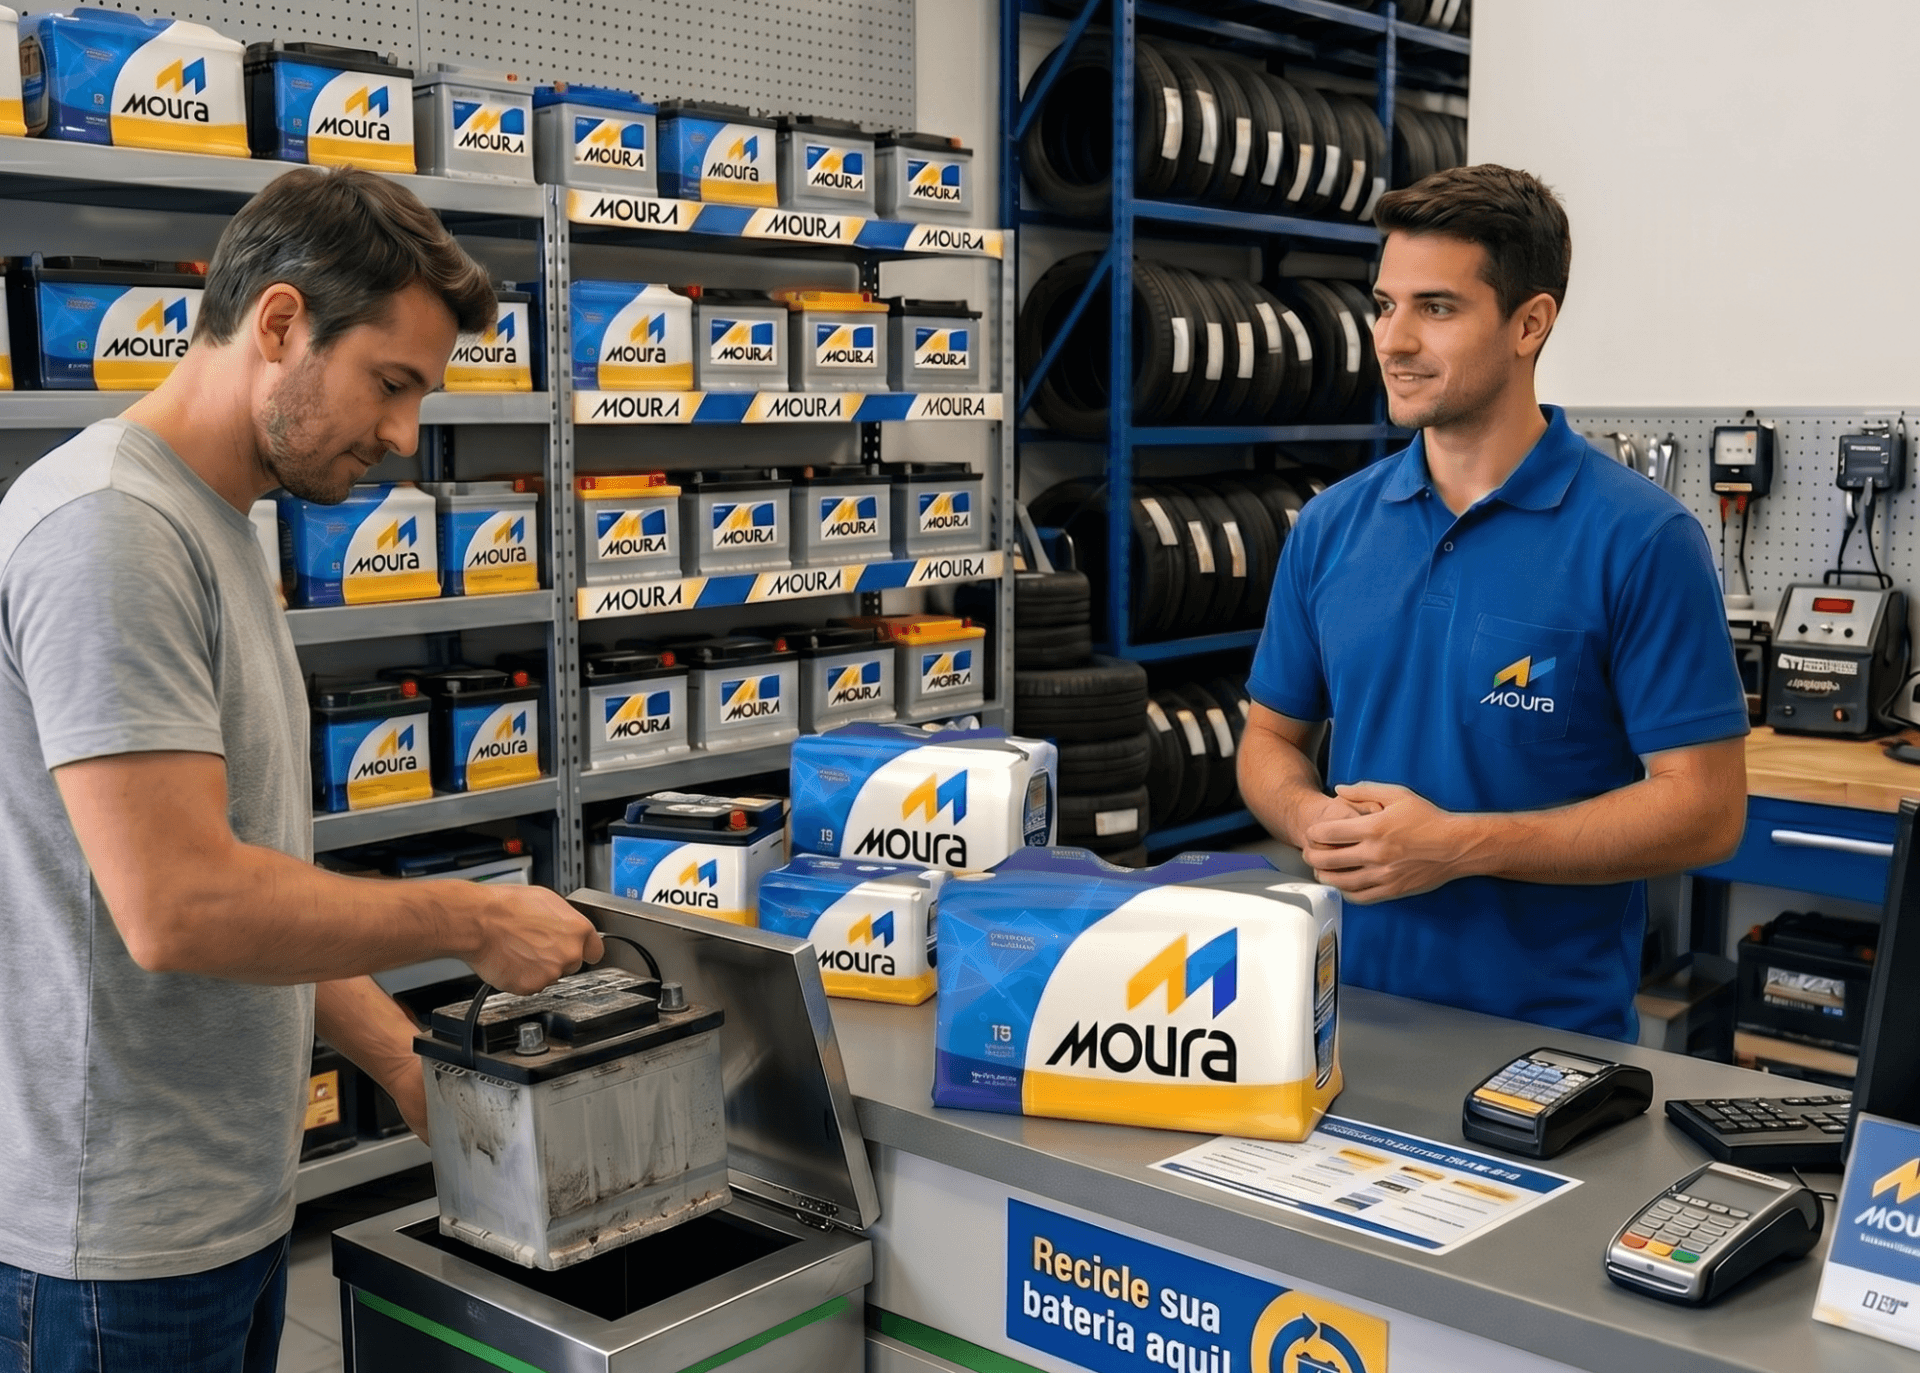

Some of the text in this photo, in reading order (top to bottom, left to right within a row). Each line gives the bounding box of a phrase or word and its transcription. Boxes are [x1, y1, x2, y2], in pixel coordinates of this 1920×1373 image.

[458, 132, 525, 153] MOURA
[583, 147, 644, 167] MOURA
[811, 172, 864, 190] MOURA
[590, 199, 985, 251] MOURA MOURA MOURA
[717, 346, 774, 361] MOURA
[820, 348, 874, 364] MOURA
[921, 353, 967, 366] MOURA
[592, 397, 985, 418] MOURA MOURA MOURA
[825, 520, 876, 538] MOURA
[922, 514, 969, 531] MOURA
[601, 537, 667, 558] MOURA
[716, 528, 774, 546] MOURA
[596, 558, 985, 613] MOURA MOURA MOURA
[831, 685, 881, 706] MOURA
[725, 699, 780, 722] MOURA
[610, 715, 671, 740] MOURA
[1033, 1235, 1221, 1335] Recicle sua
[1023, 1280, 1135, 1353] bateria
